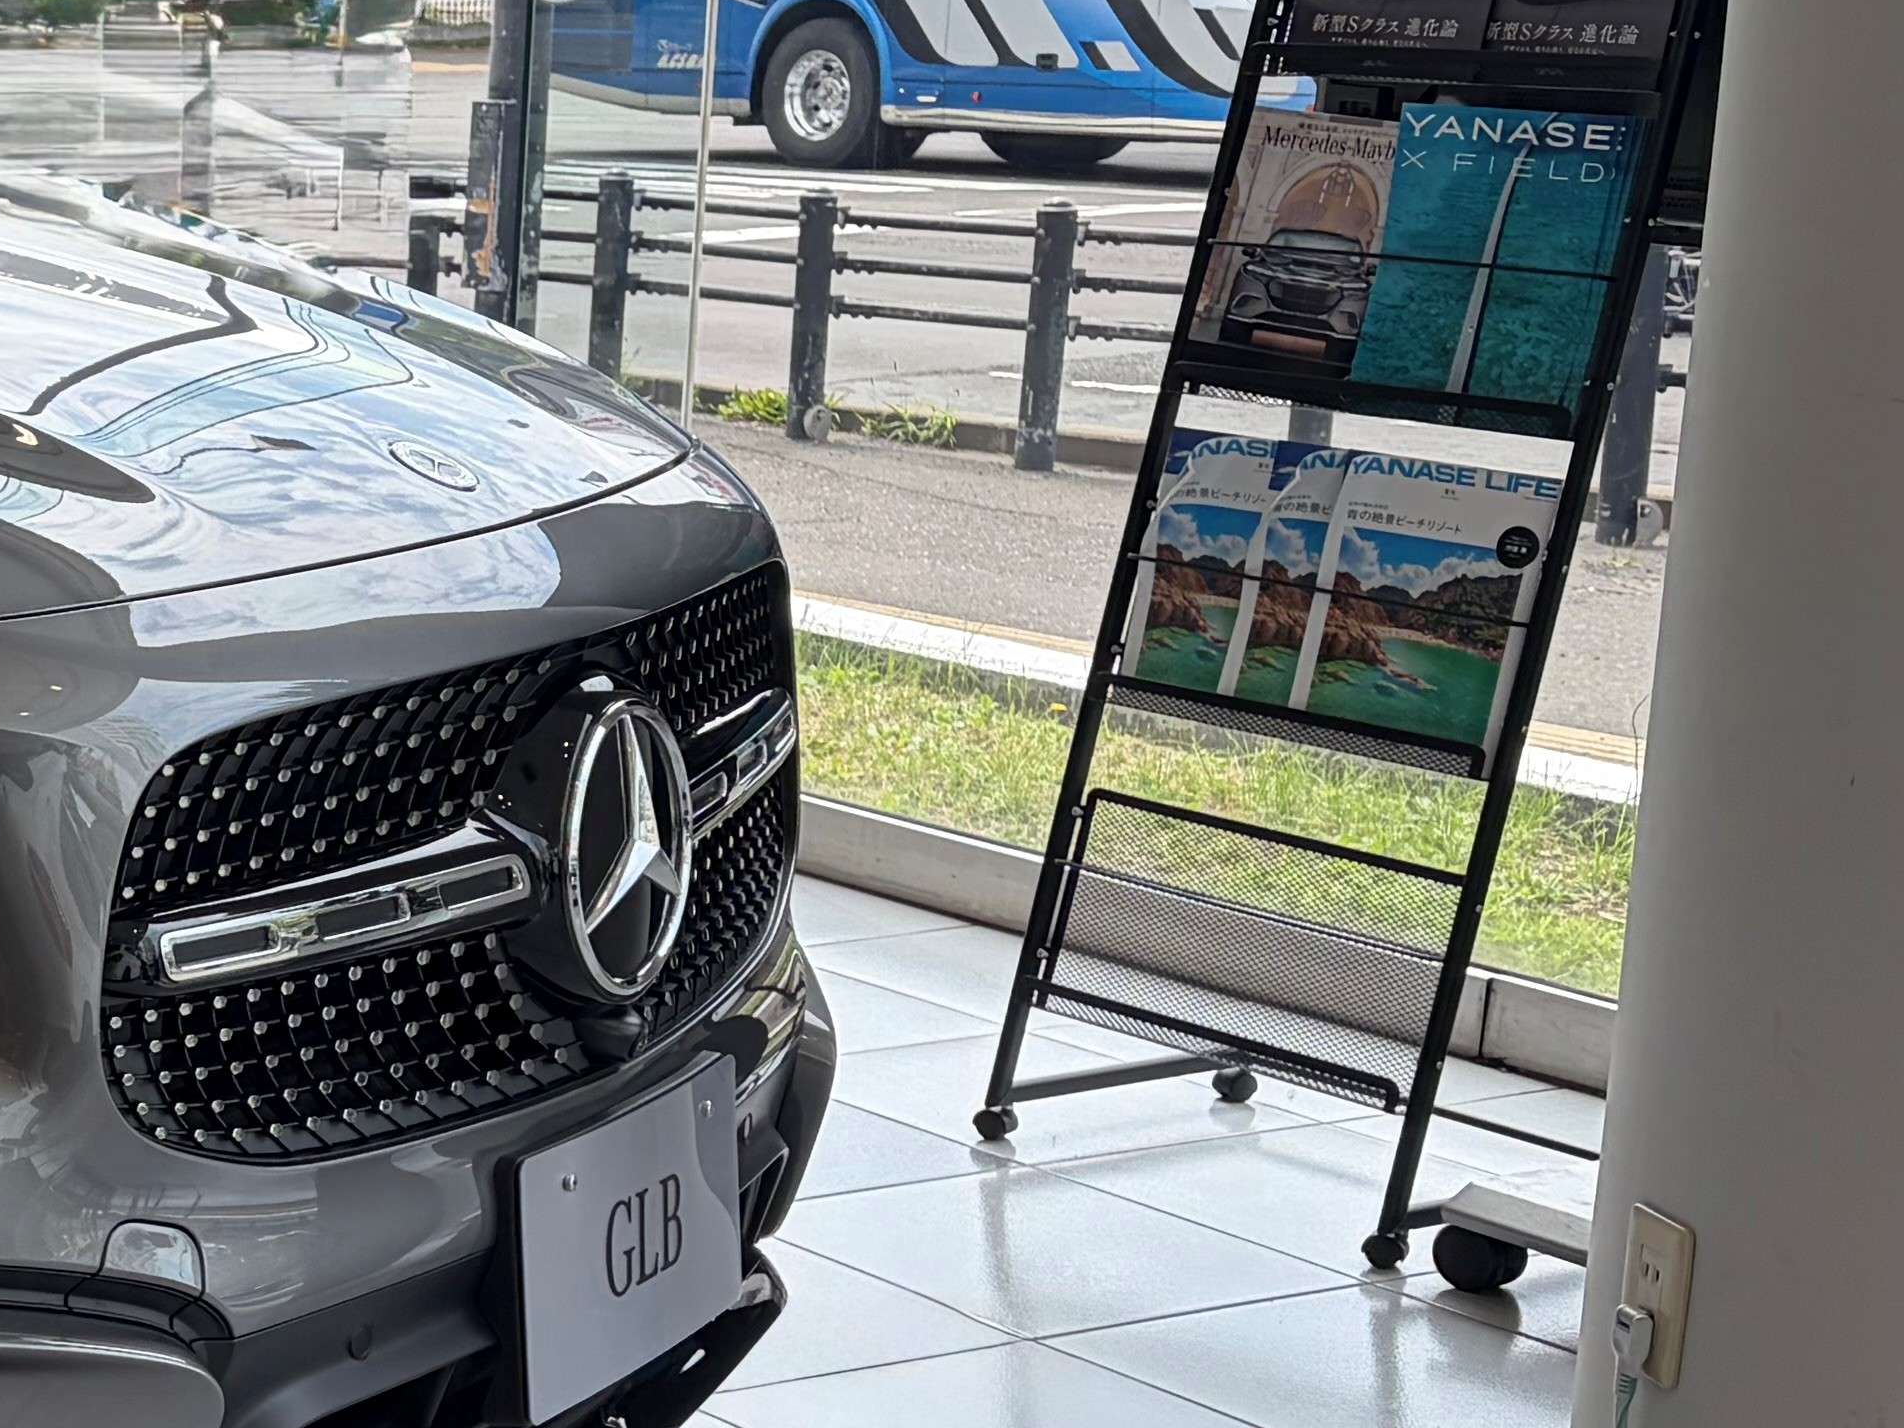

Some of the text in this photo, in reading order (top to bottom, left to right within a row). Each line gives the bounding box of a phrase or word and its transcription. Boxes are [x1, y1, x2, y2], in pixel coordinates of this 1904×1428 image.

[1579, 23, 1640, 45] 進化論
[1404, 111, 1615, 152] YANASE
[1453, 152, 1605, 183] FIELD
[1352, 455, 1563, 500] YANASE LIFE
[605, 1172, 683, 1298] GLB
